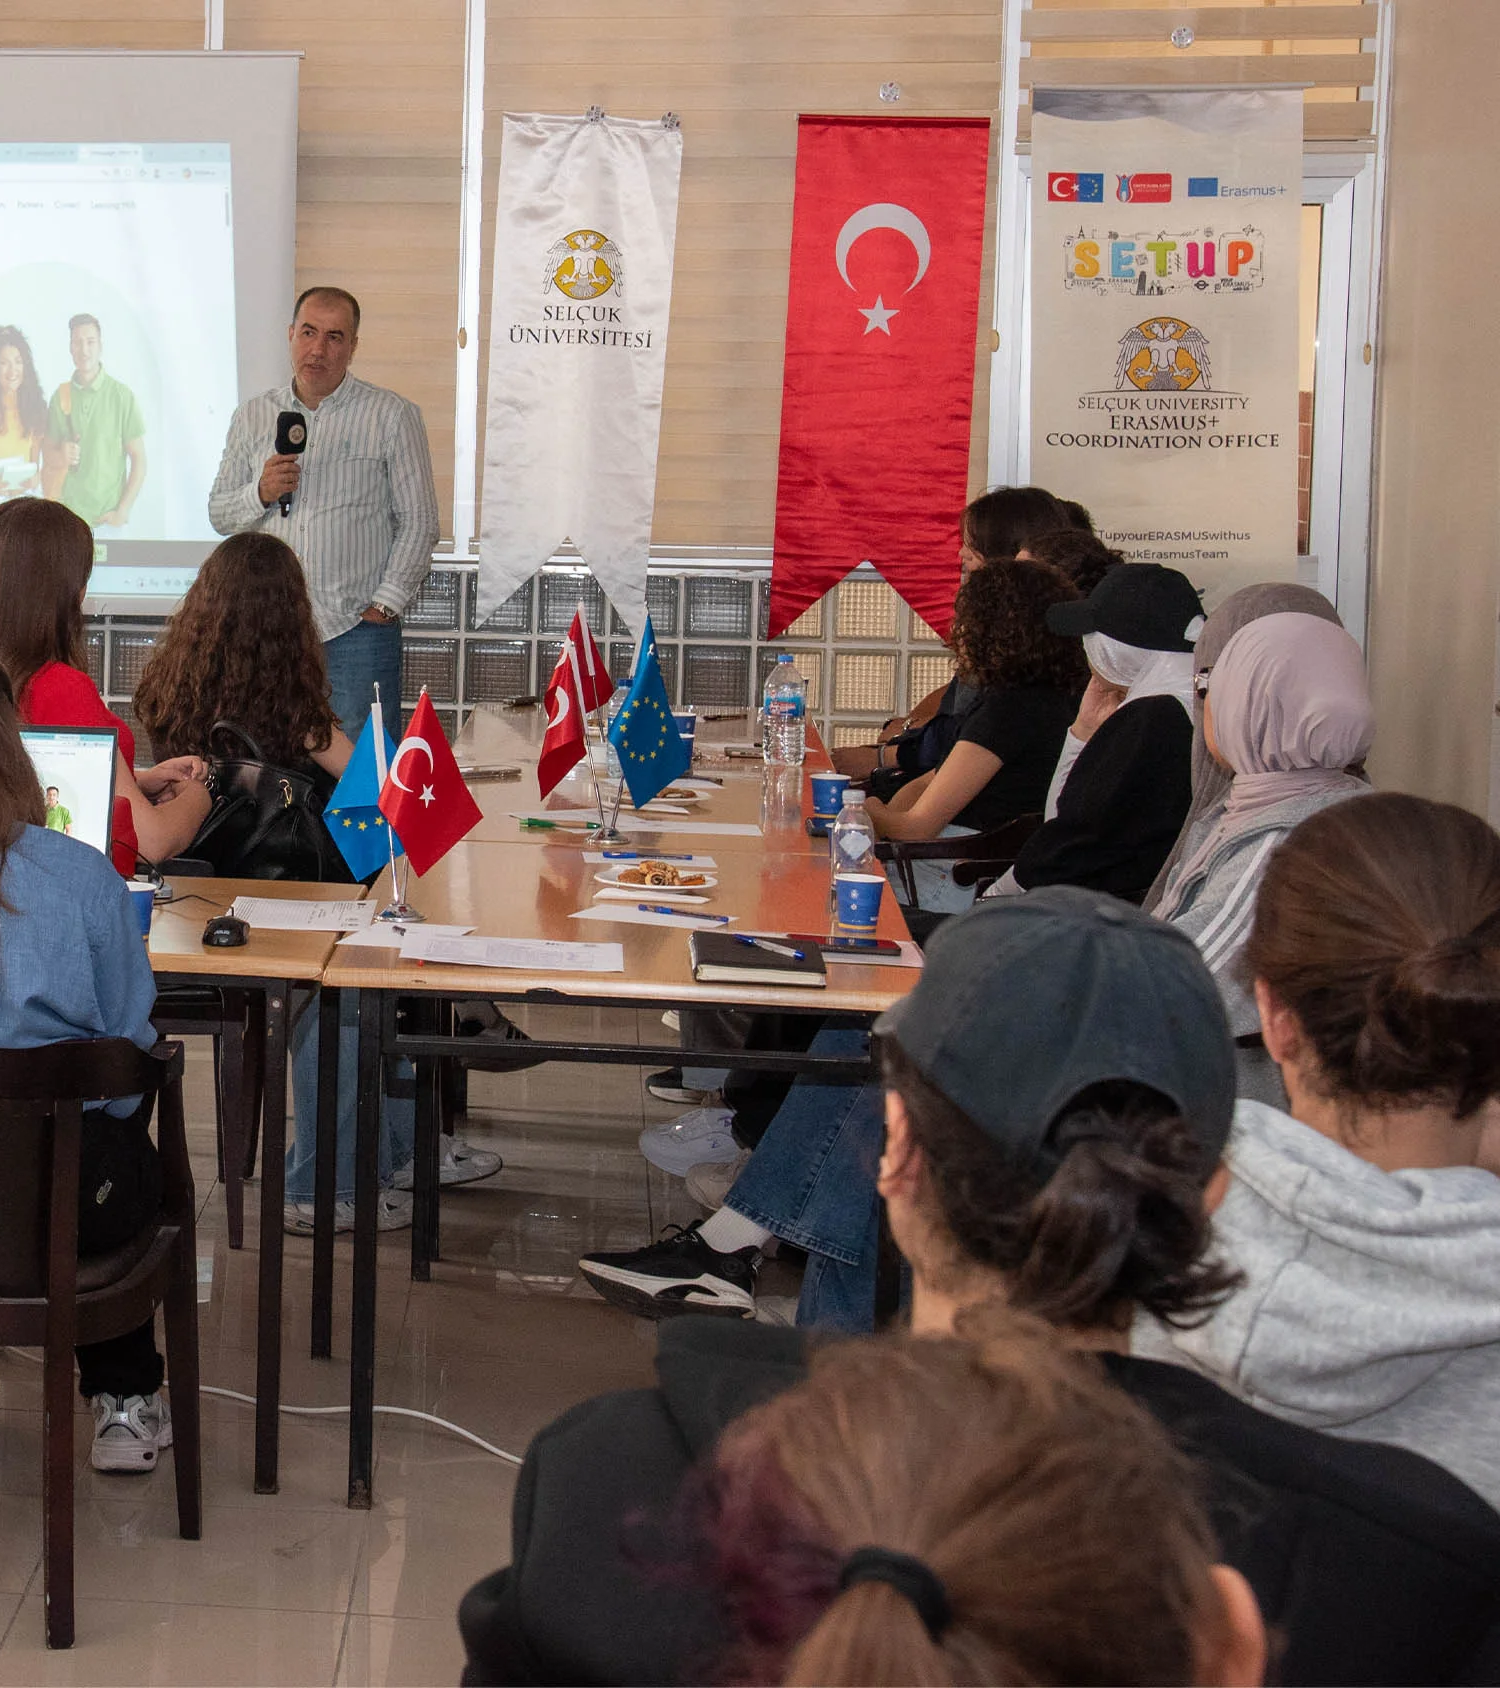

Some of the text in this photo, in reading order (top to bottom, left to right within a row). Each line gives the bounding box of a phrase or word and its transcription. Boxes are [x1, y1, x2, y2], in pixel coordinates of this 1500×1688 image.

[1221, 185, 1287, 197] Erasmus+
[1074, 240, 1254, 279] SETUP
[543, 305, 622, 325] SELÇUK
[509, 324, 652, 348] ÜNİVERSİTESİ
[1078, 396, 1249, 412] SELÇUK UNIVERSITY
[1111, 415, 1220, 431] ERASMUS+
[1046, 433, 1279, 449] COORDINATION OFFICE
[1097, 530, 1251, 543] TupyourERASMUSwithus
[1121, 549, 1229, 560] cukErasmusTeam
